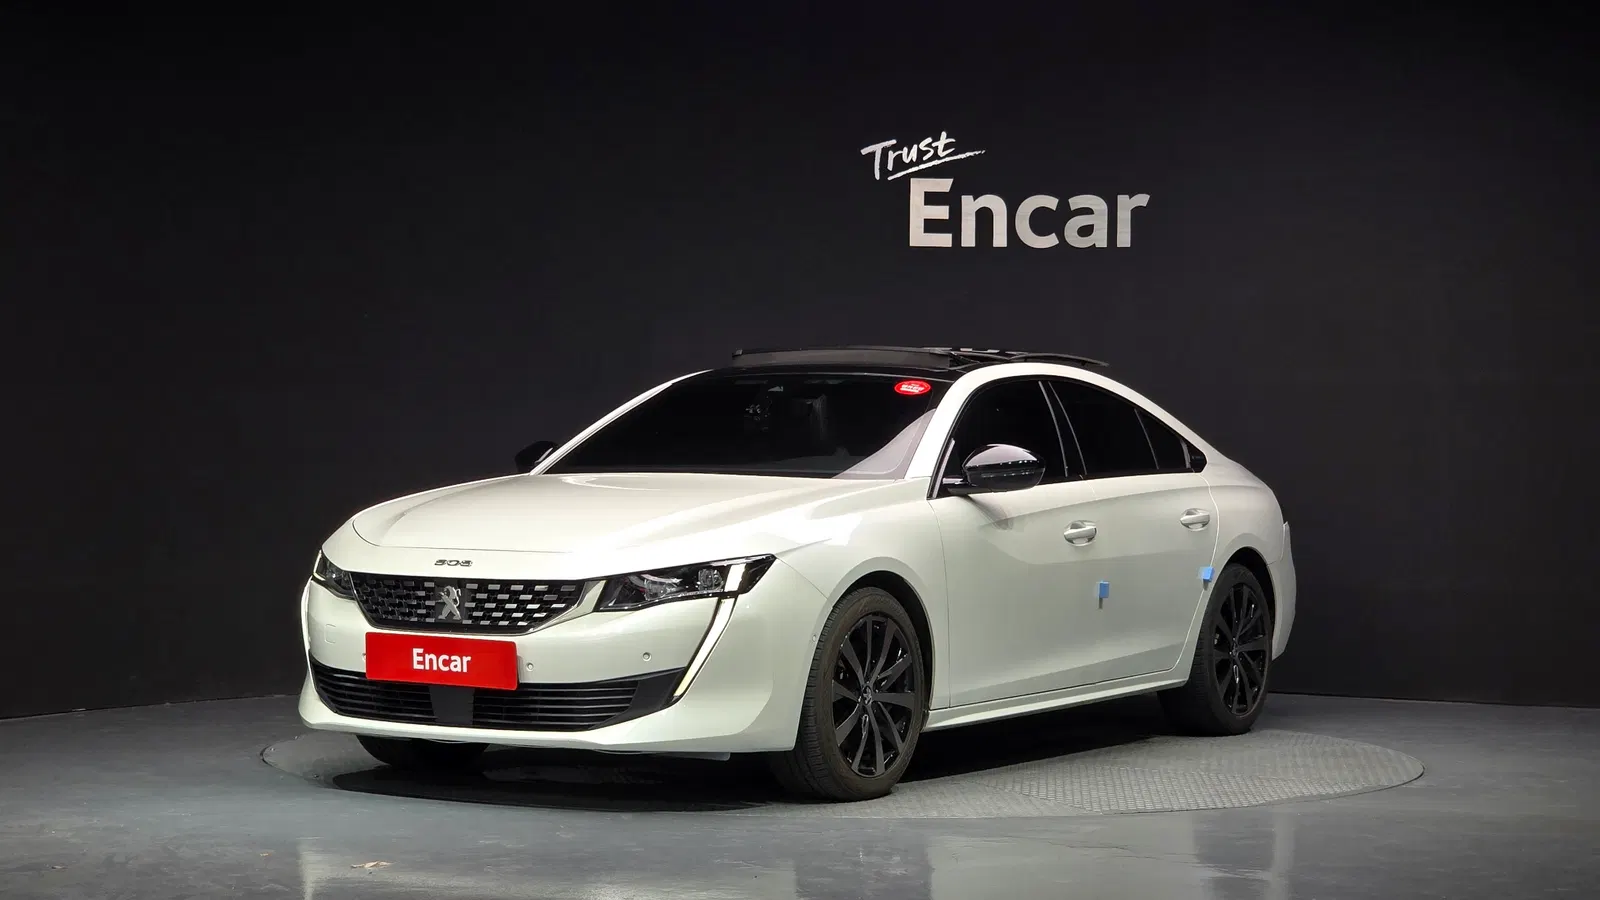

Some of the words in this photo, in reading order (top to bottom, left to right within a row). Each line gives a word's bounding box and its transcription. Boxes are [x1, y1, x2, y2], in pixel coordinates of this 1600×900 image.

[860, 130, 957, 181] Trust
[909, 177, 1151, 249] Encar
[412, 648, 472, 673] Encar
